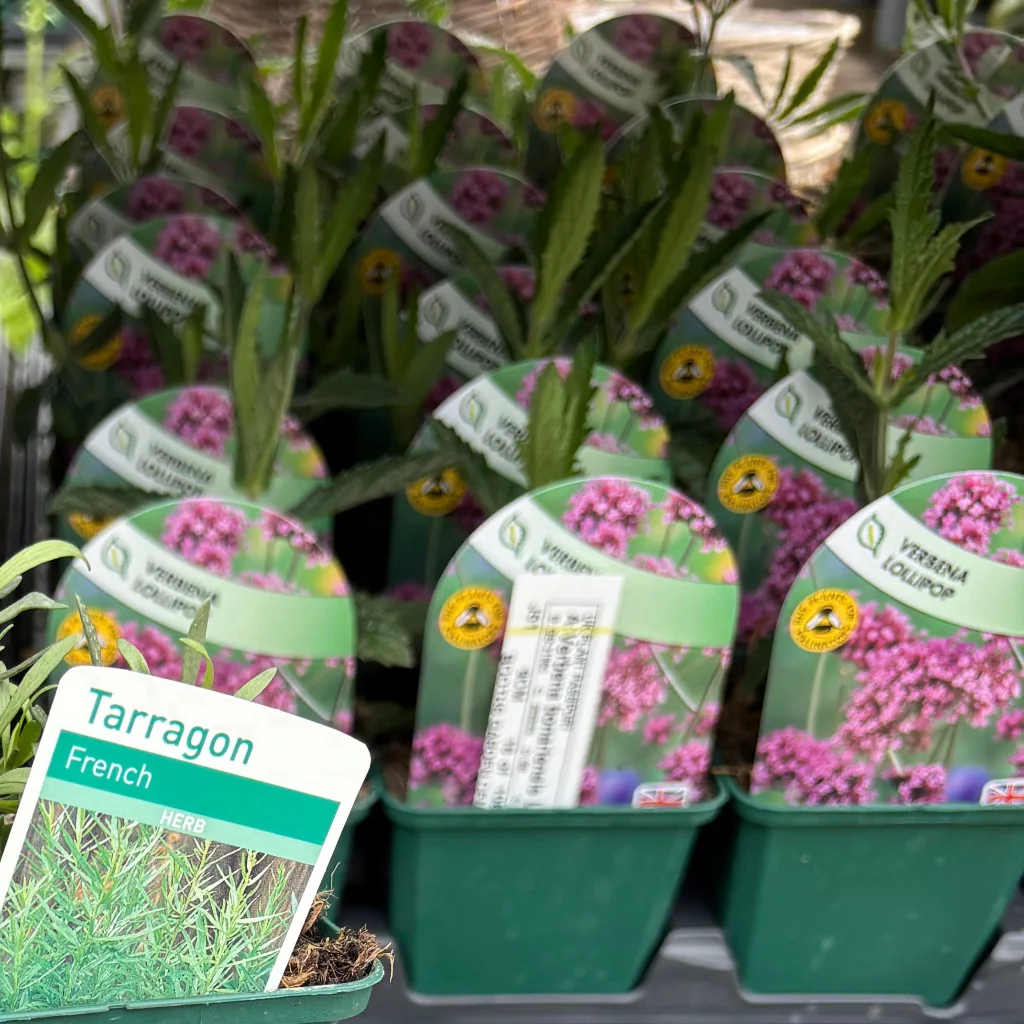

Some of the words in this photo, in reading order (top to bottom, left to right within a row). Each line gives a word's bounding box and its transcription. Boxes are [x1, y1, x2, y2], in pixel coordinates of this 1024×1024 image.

[881, 556, 956, 601] LOLLIPOP
[899, 536, 969, 585] VERBENA
[132, 576, 204, 619] LOLLIPO
[87, 687, 254, 765] Tarragon
[65, 745, 153, 789] French
[159, 809, 207, 834] HERB
